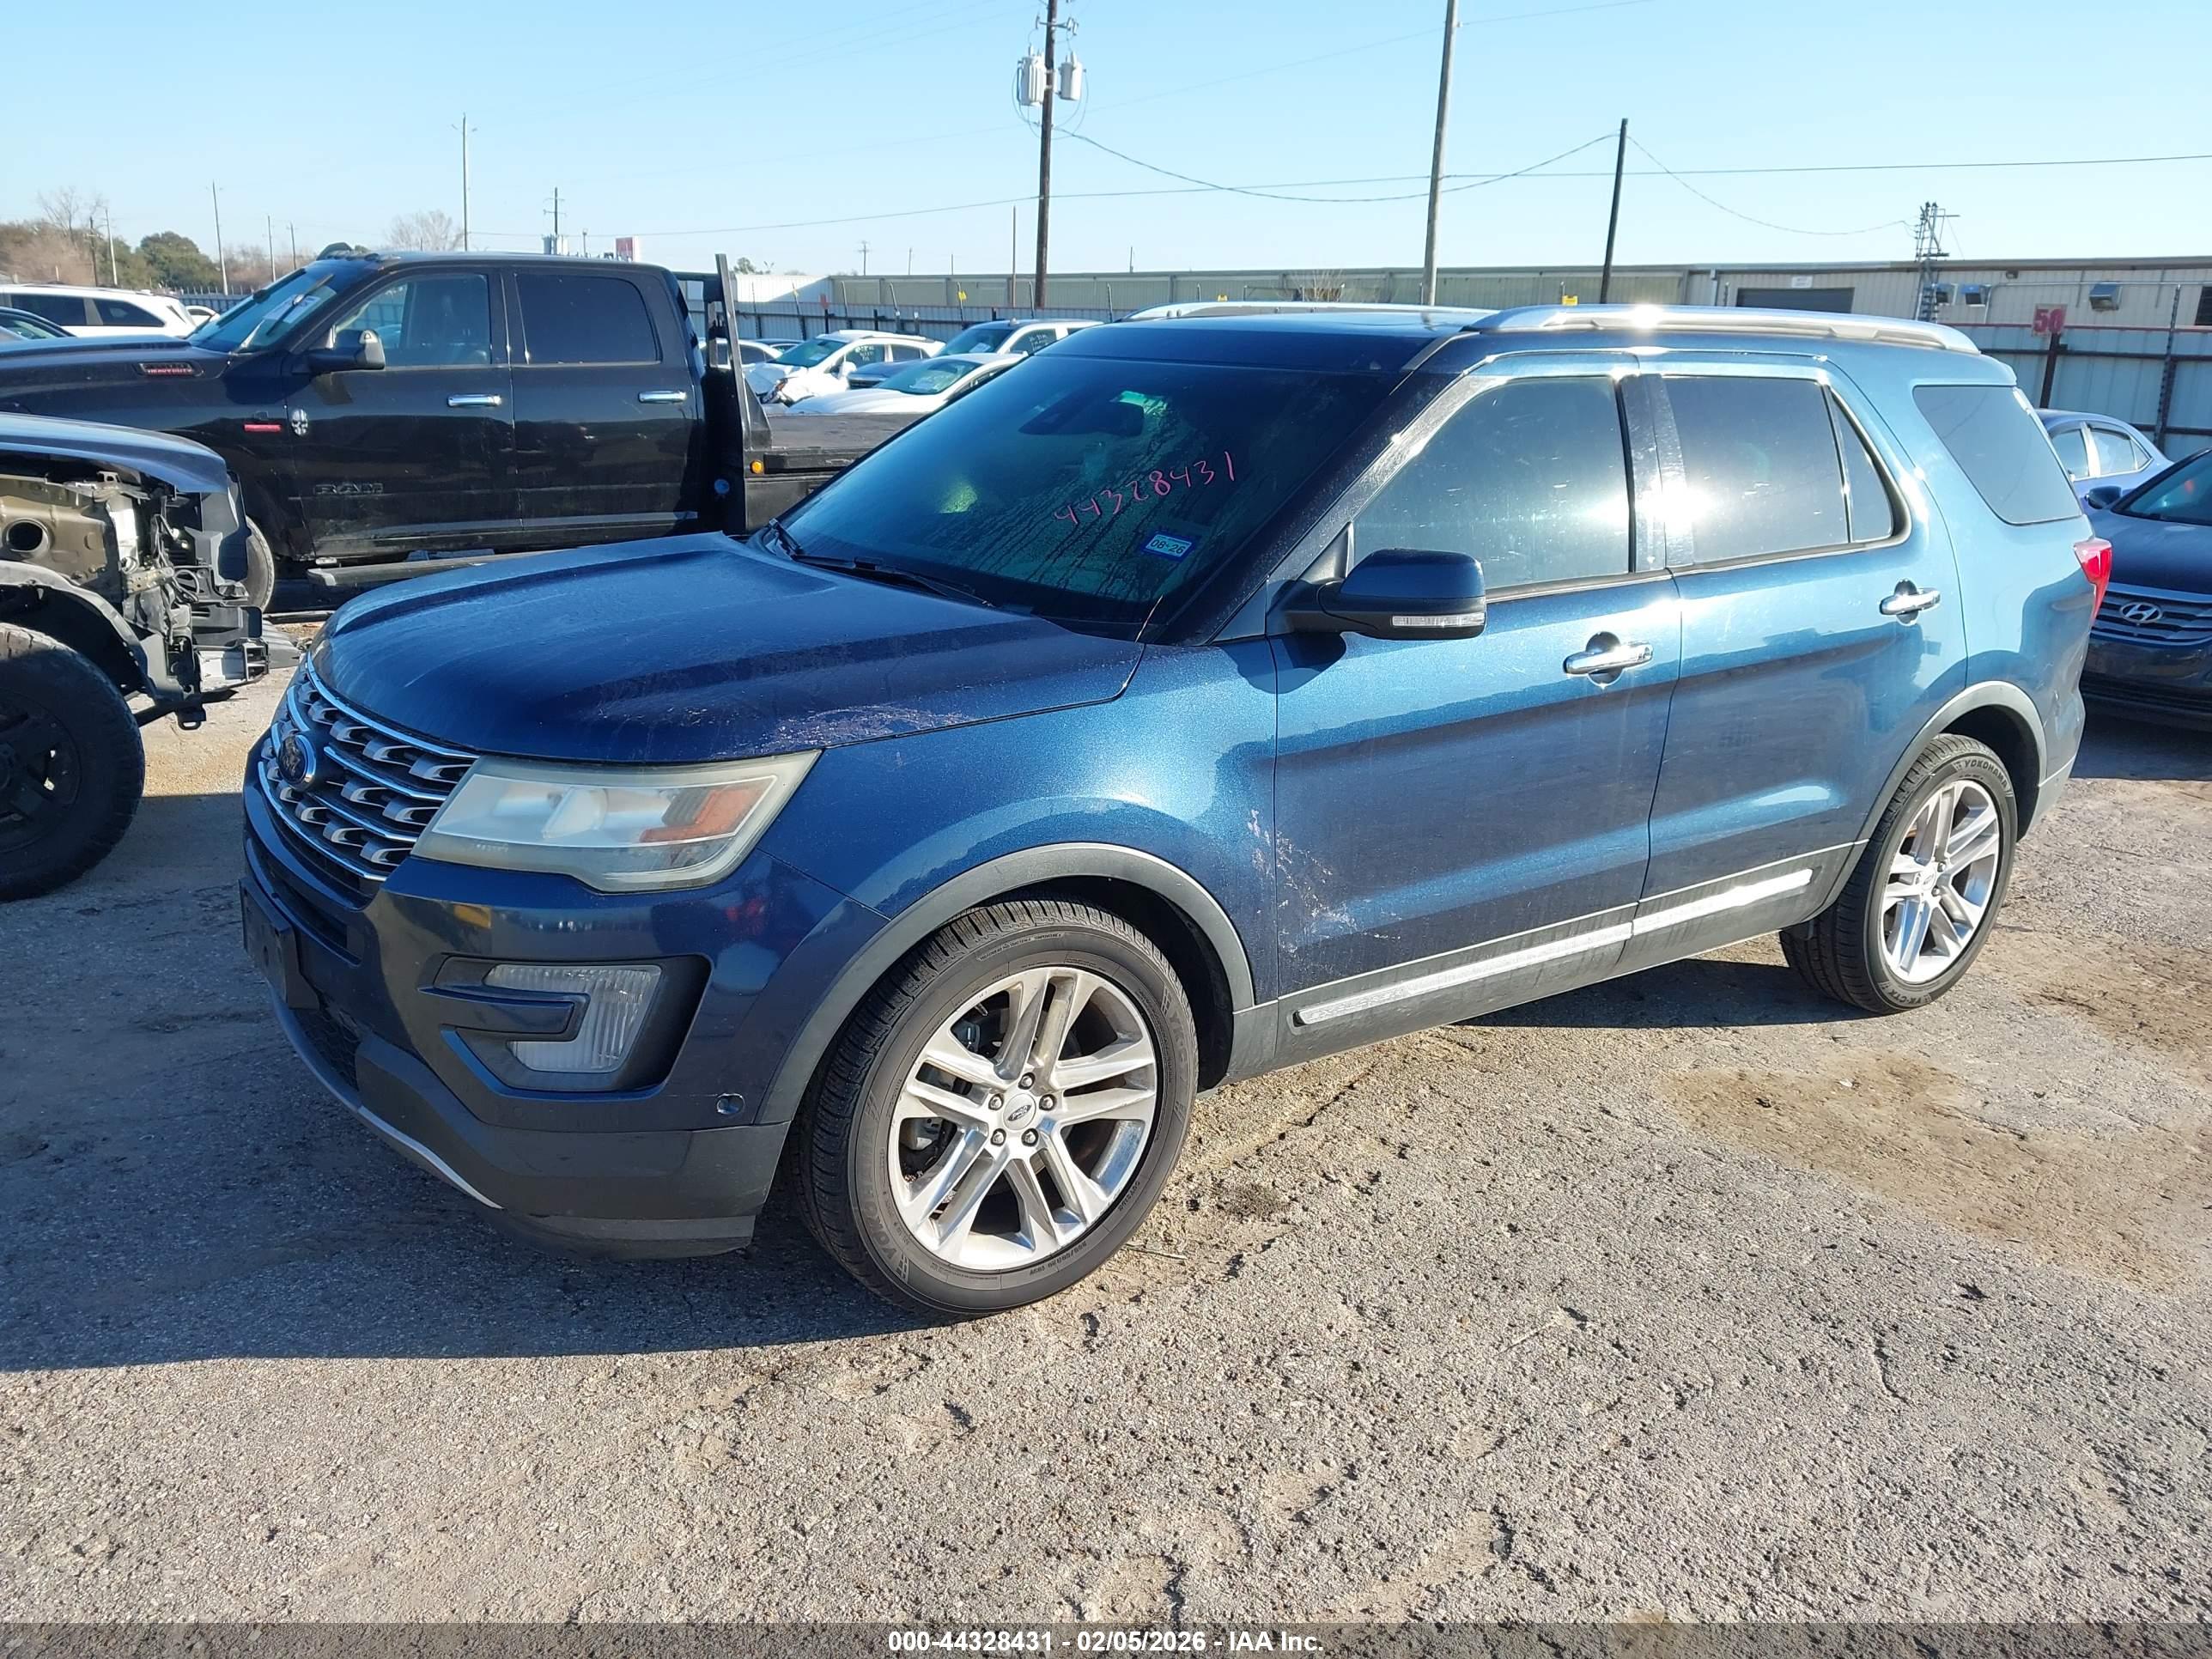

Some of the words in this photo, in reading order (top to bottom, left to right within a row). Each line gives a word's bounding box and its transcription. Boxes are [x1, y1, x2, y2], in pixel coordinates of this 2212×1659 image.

[2033, 308, 2065, 333] 50
[1054, 451, 1235, 525] 44328431
[1964, 759, 2008, 789] YOKOHAMA
